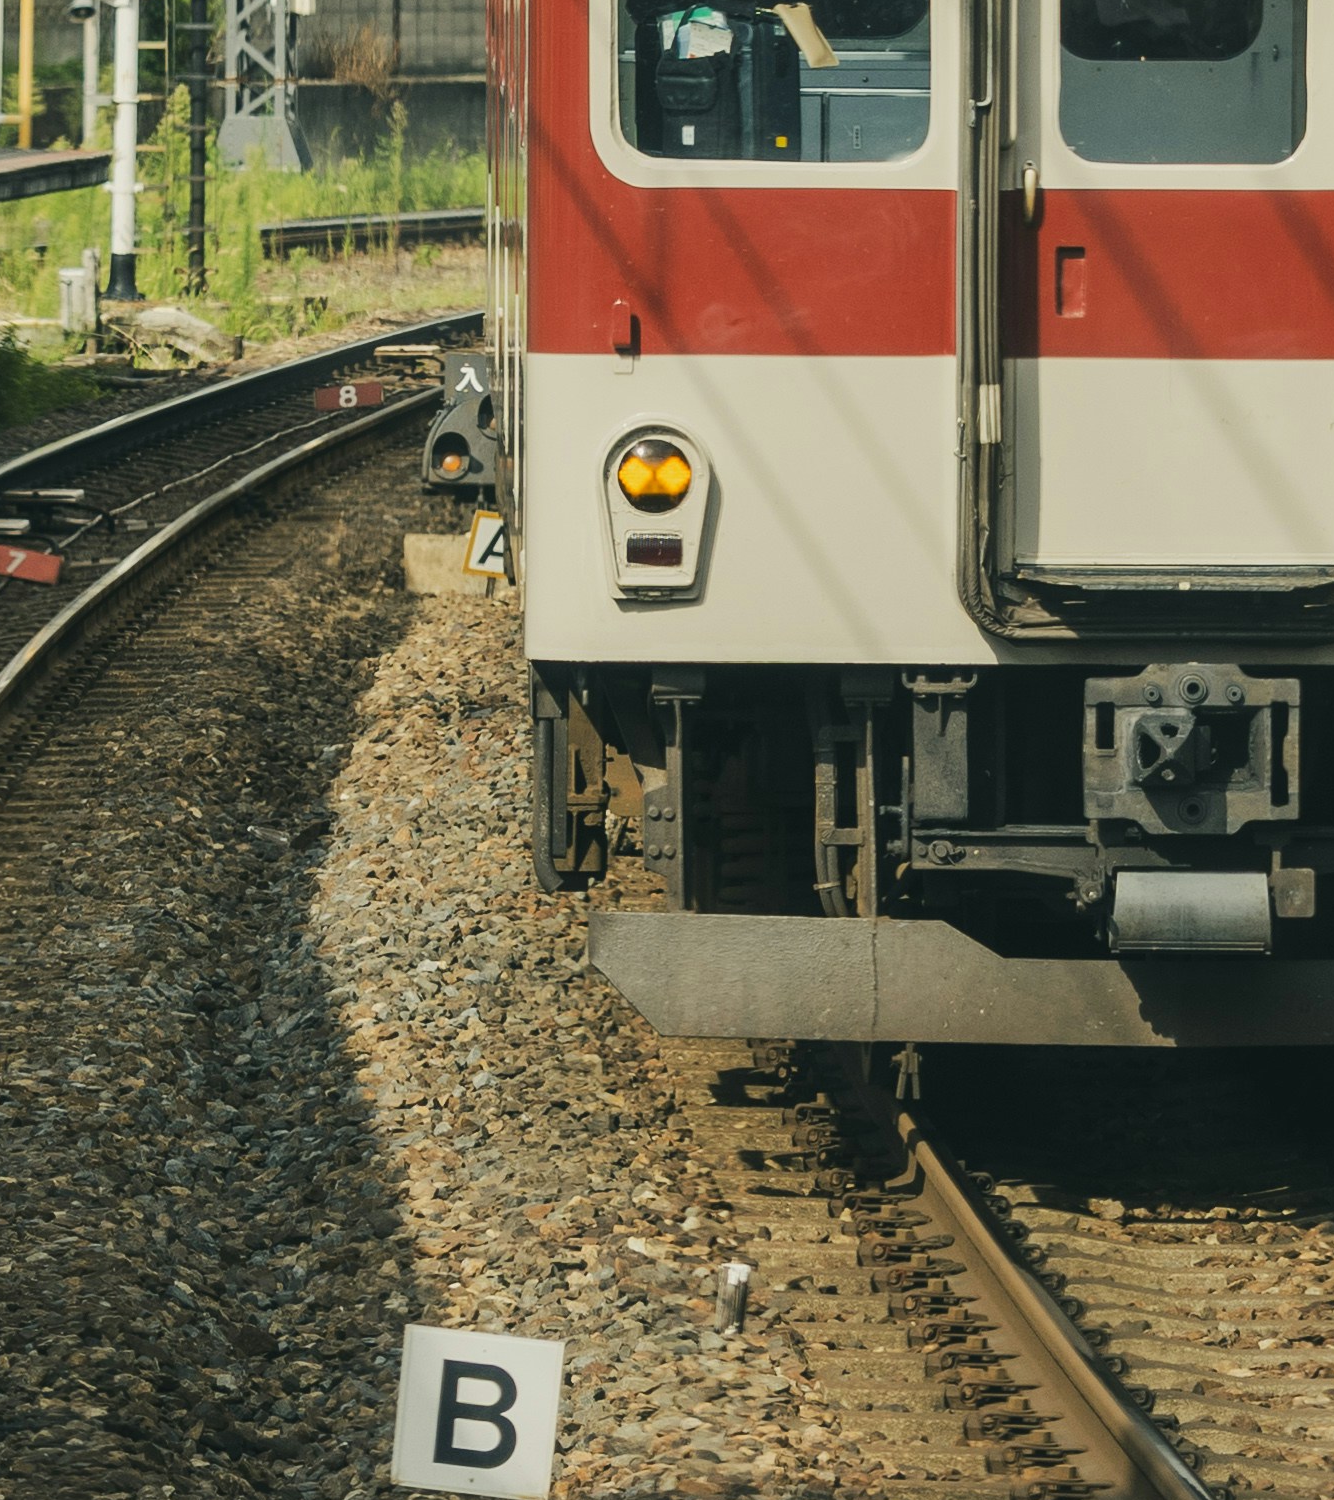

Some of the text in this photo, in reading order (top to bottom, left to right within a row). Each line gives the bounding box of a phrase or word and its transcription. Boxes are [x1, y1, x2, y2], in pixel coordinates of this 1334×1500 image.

[339, 385, 358, 408] 8
[477, 523, 505, 565] A
[6, 550, 27, 574] 7
[433, 1359, 517, 1469] B
